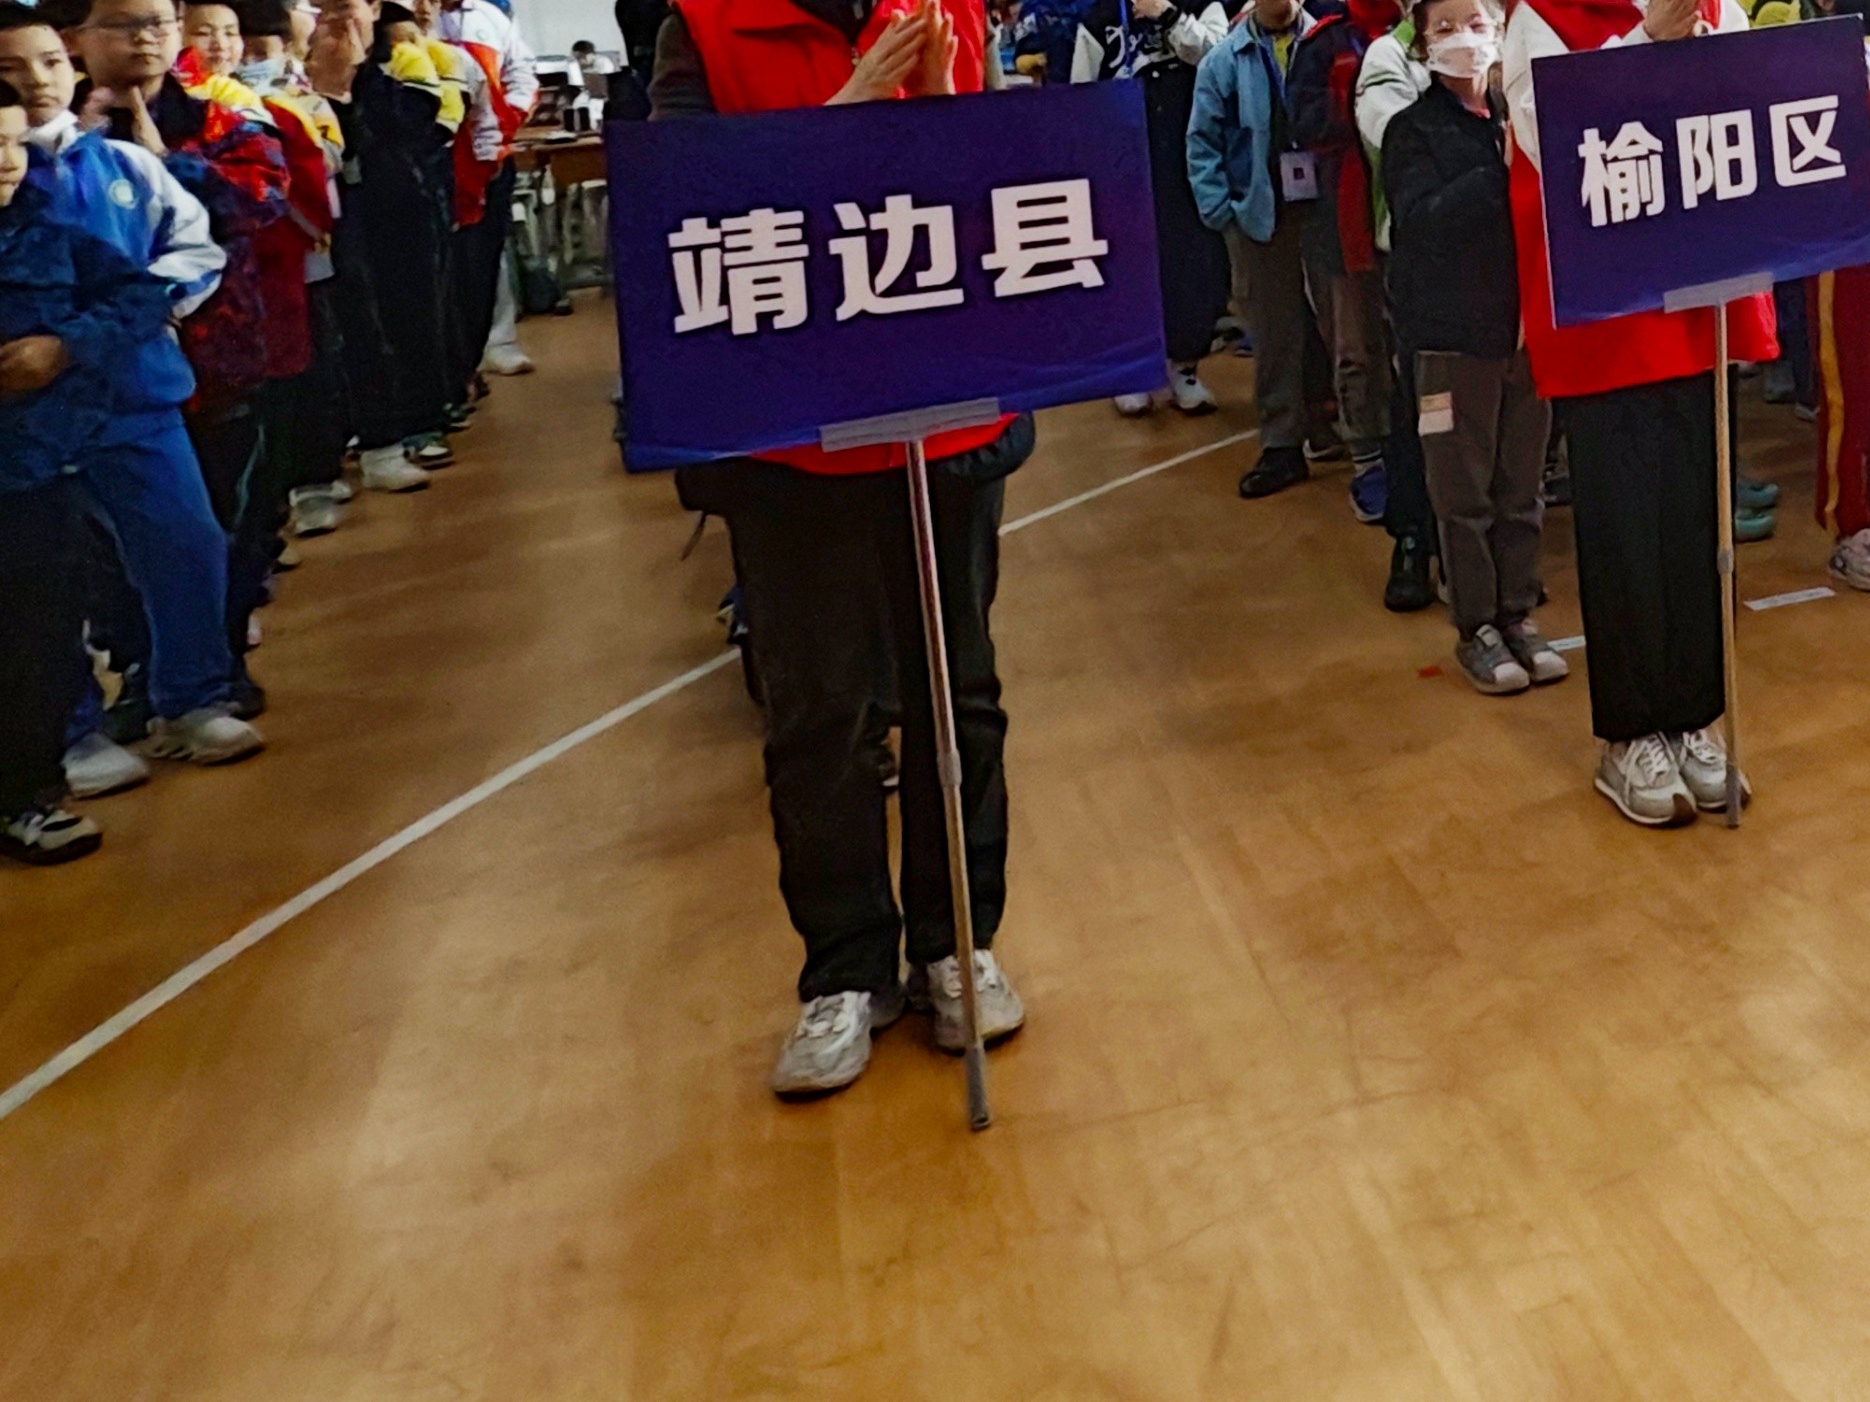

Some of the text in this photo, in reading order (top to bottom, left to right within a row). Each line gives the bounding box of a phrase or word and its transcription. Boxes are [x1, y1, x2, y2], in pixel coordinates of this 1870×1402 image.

[1578, 95, 1847, 227] 榆阳区
[668, 178, 1109, 336] 靖边县
